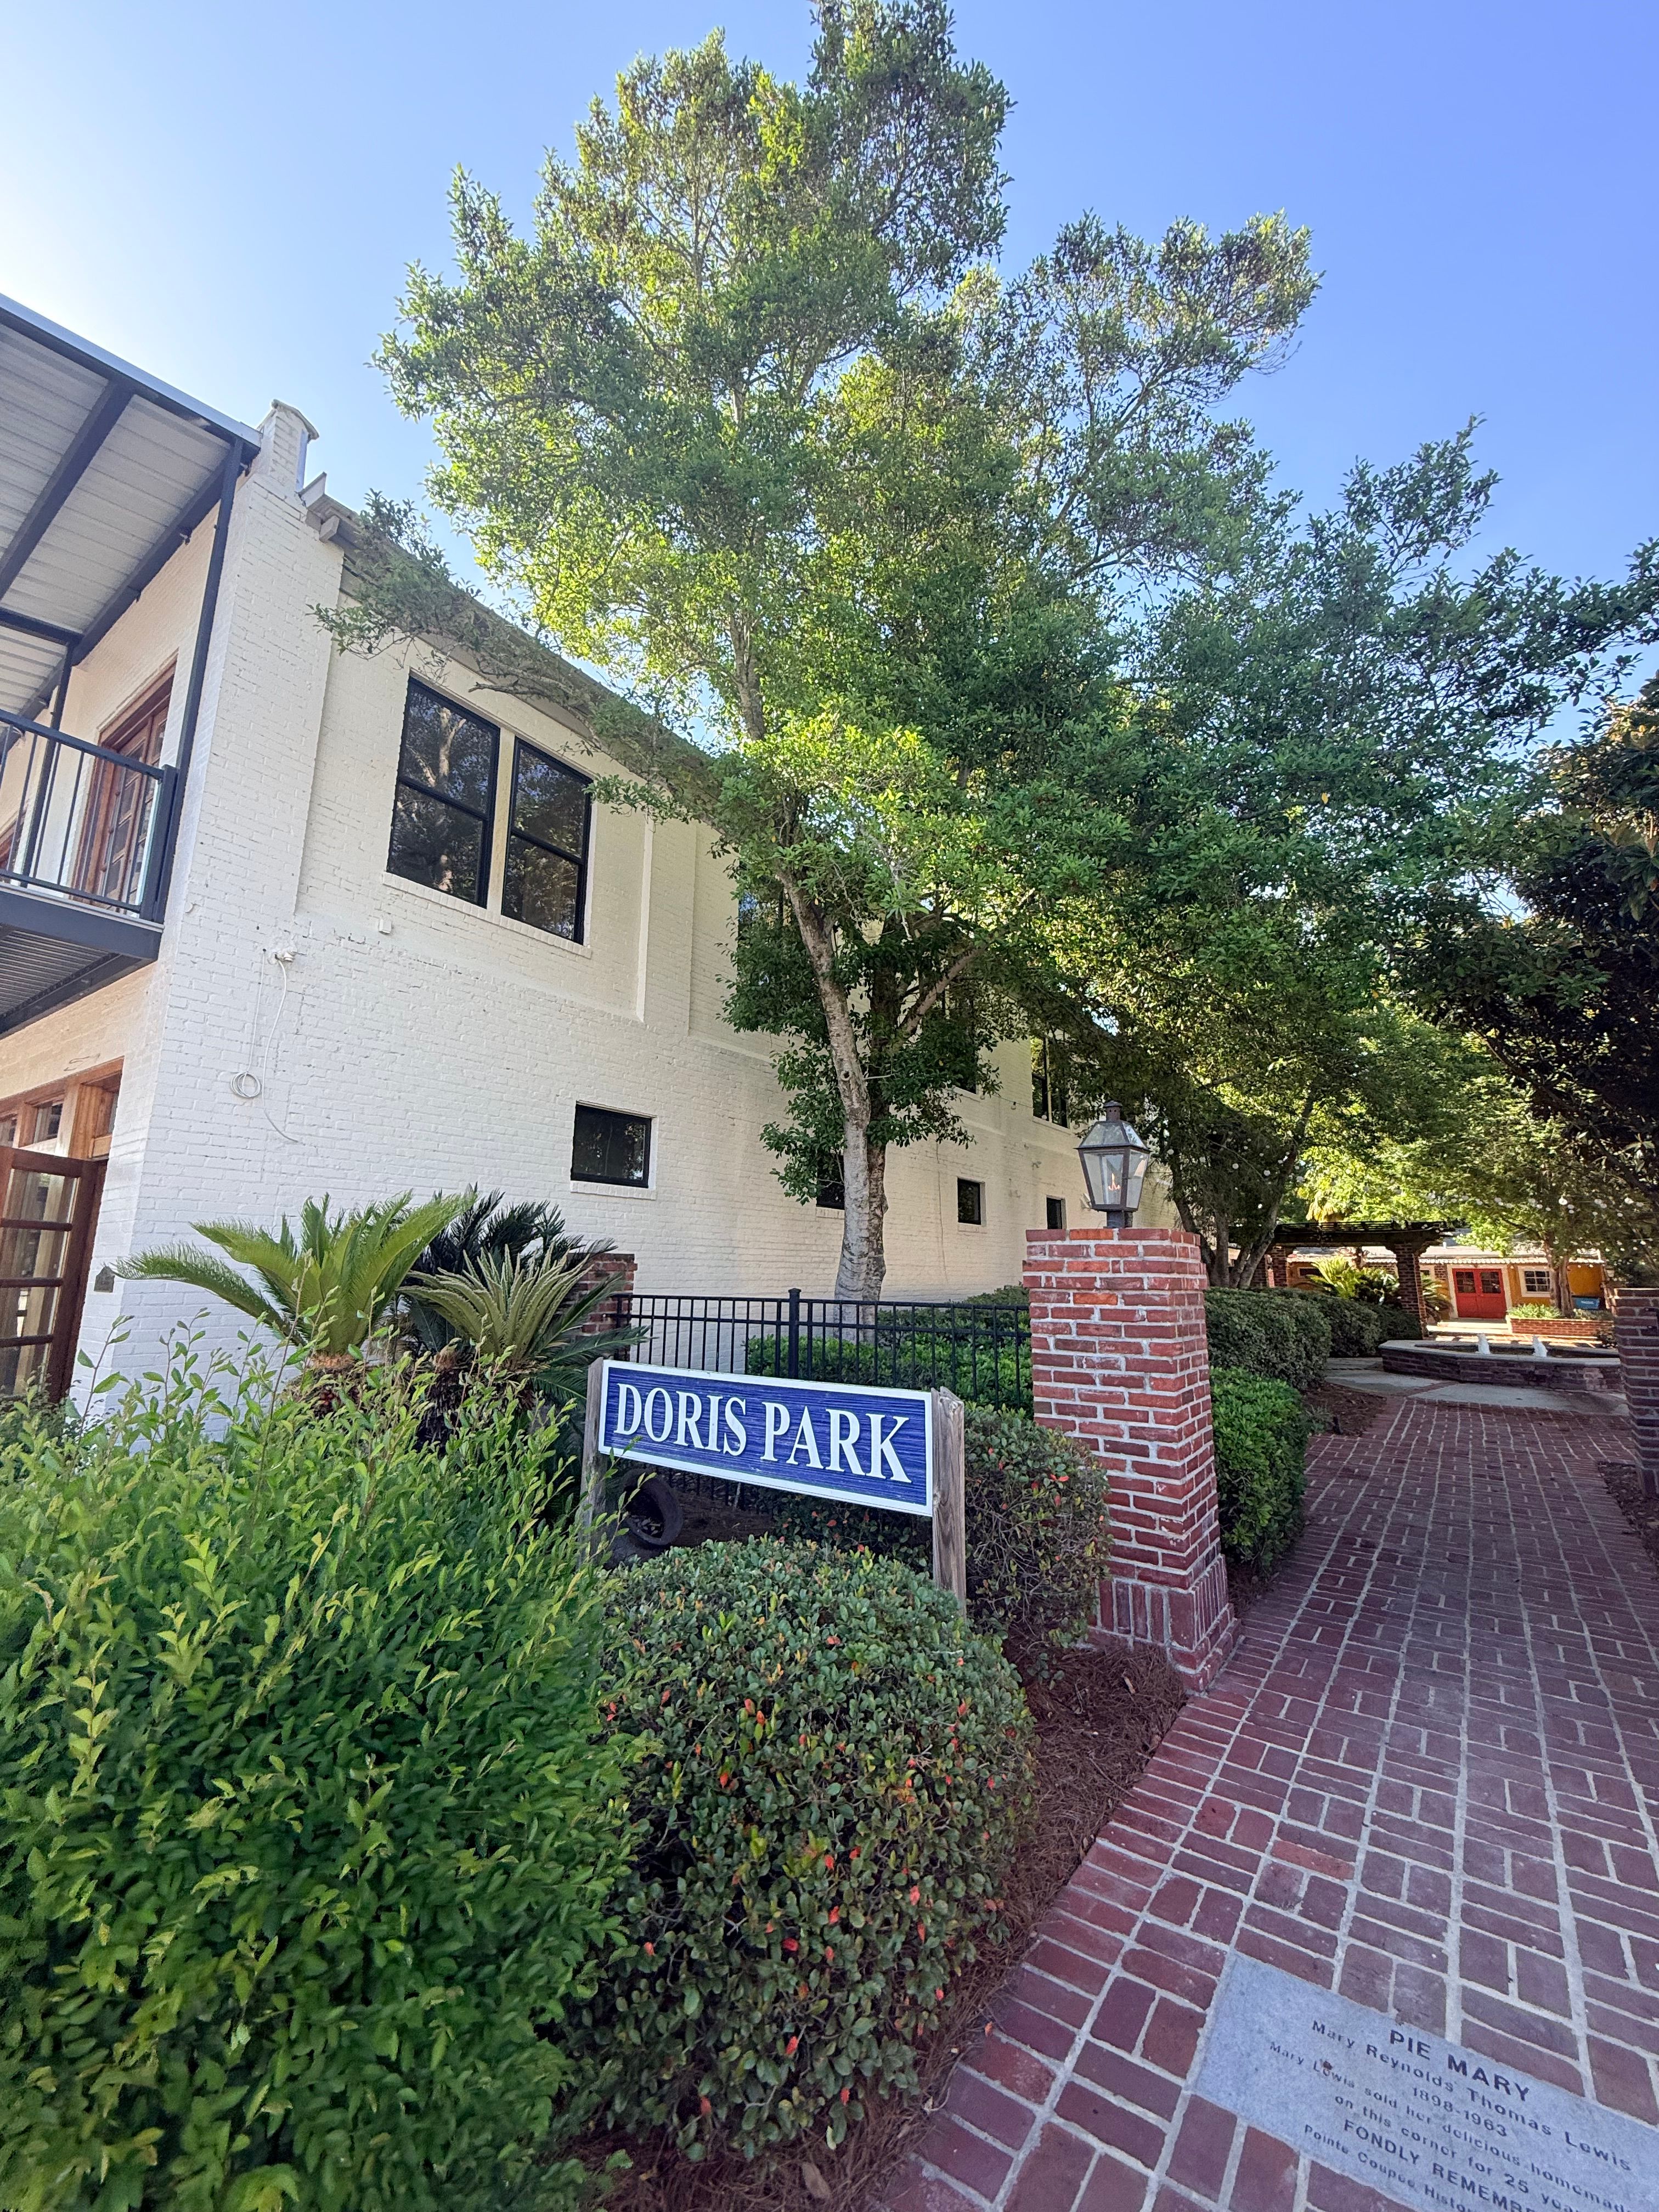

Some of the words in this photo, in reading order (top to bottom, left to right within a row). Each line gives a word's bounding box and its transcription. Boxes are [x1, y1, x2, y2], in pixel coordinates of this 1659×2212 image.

[613, 1383, 747, 1457] DORIS
[760, 1401, 912, 1484] PARK
[1312, 2019, 1355, 2049] Mary
[1366, 2044, 1453, 2093] Reynolds
[1466, 2087, 1551, 2136] Thomas
[1565, 2131, 1631, 2171] Lewis
[1390, 2029, 1431, 2061] PIE
[1447, 2053, 1530, 2102] MARY
[1269, 2041, 1305, 2065] Mary
[1313, 2060, 1355, 2089] Lewis
[1364, 2087, 1397, 2109] sold
[1406, 2105, 1431, 2125] her
[1442, 2124, 1521, 2166] delicious
[1531, 2162, 1630, 2212] homemad
[1305, 2124, 1349, 2154] Pointe
[1335, 2096, 1353, 2109] on
[1363, 2106, 1392, 2128] this
[1401, 2127, 1457, 2159] corner
[1468, 2156, 1492, 2176] for
[1504, 2173, 1529, 2193] 25
[1541, 2193, 1581, 2212] yea
[1344, 2119, 1420, 2165] FONDLY
[1413, 2087, 1507, 2137] 1898-1963
